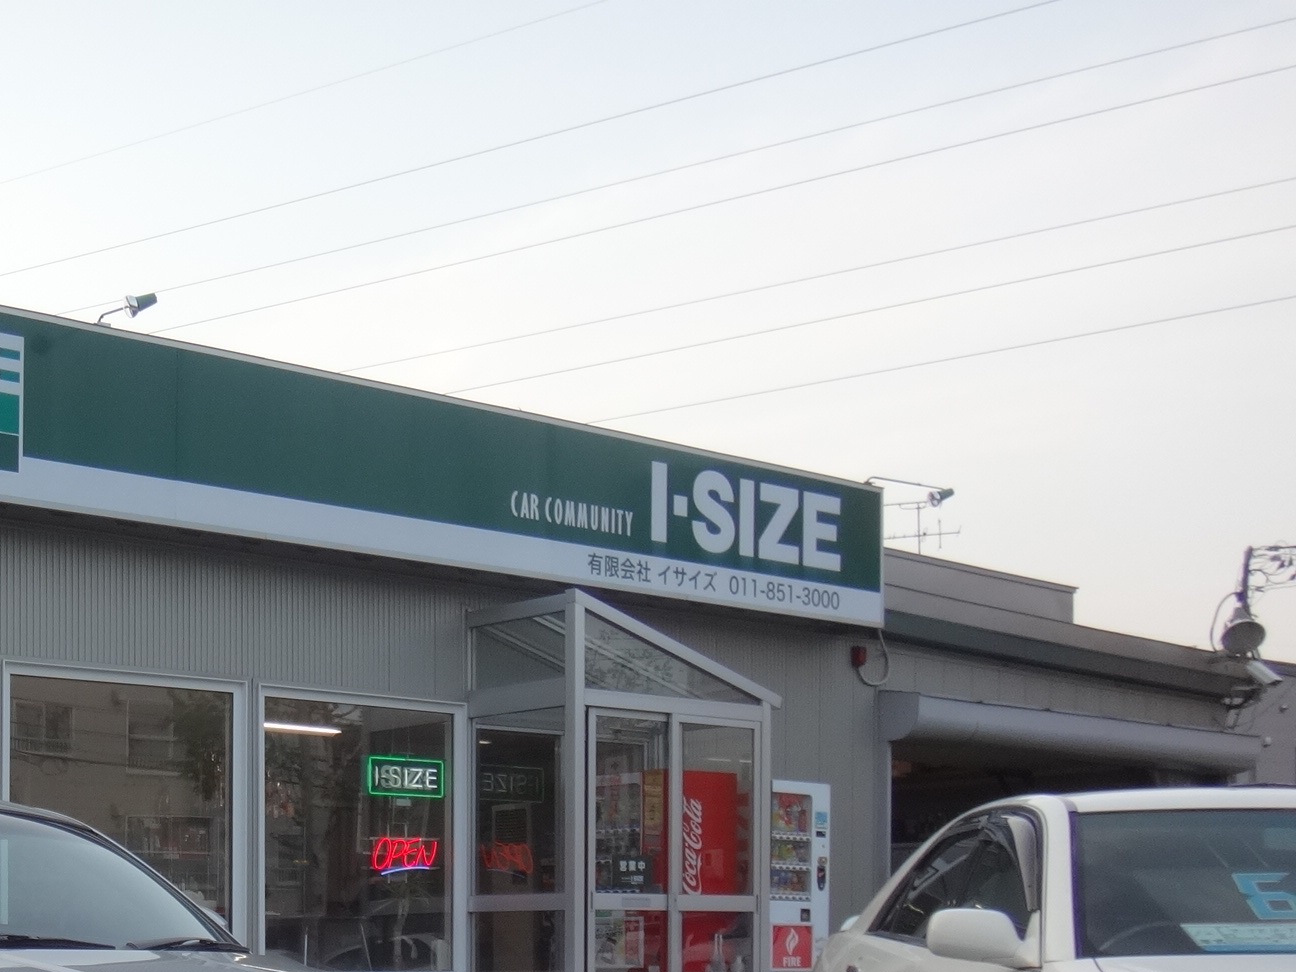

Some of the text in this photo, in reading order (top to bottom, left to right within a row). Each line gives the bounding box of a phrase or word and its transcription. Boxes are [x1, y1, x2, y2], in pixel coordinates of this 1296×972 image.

[510, 490, 634, 537] CAR COMMUNITY
[587, 552, 841, 611] 有限会社 イサイズ 011-851-3000
[372, 837, 439, 871] OPEN
[782, 956, 802, 967] FIRE
